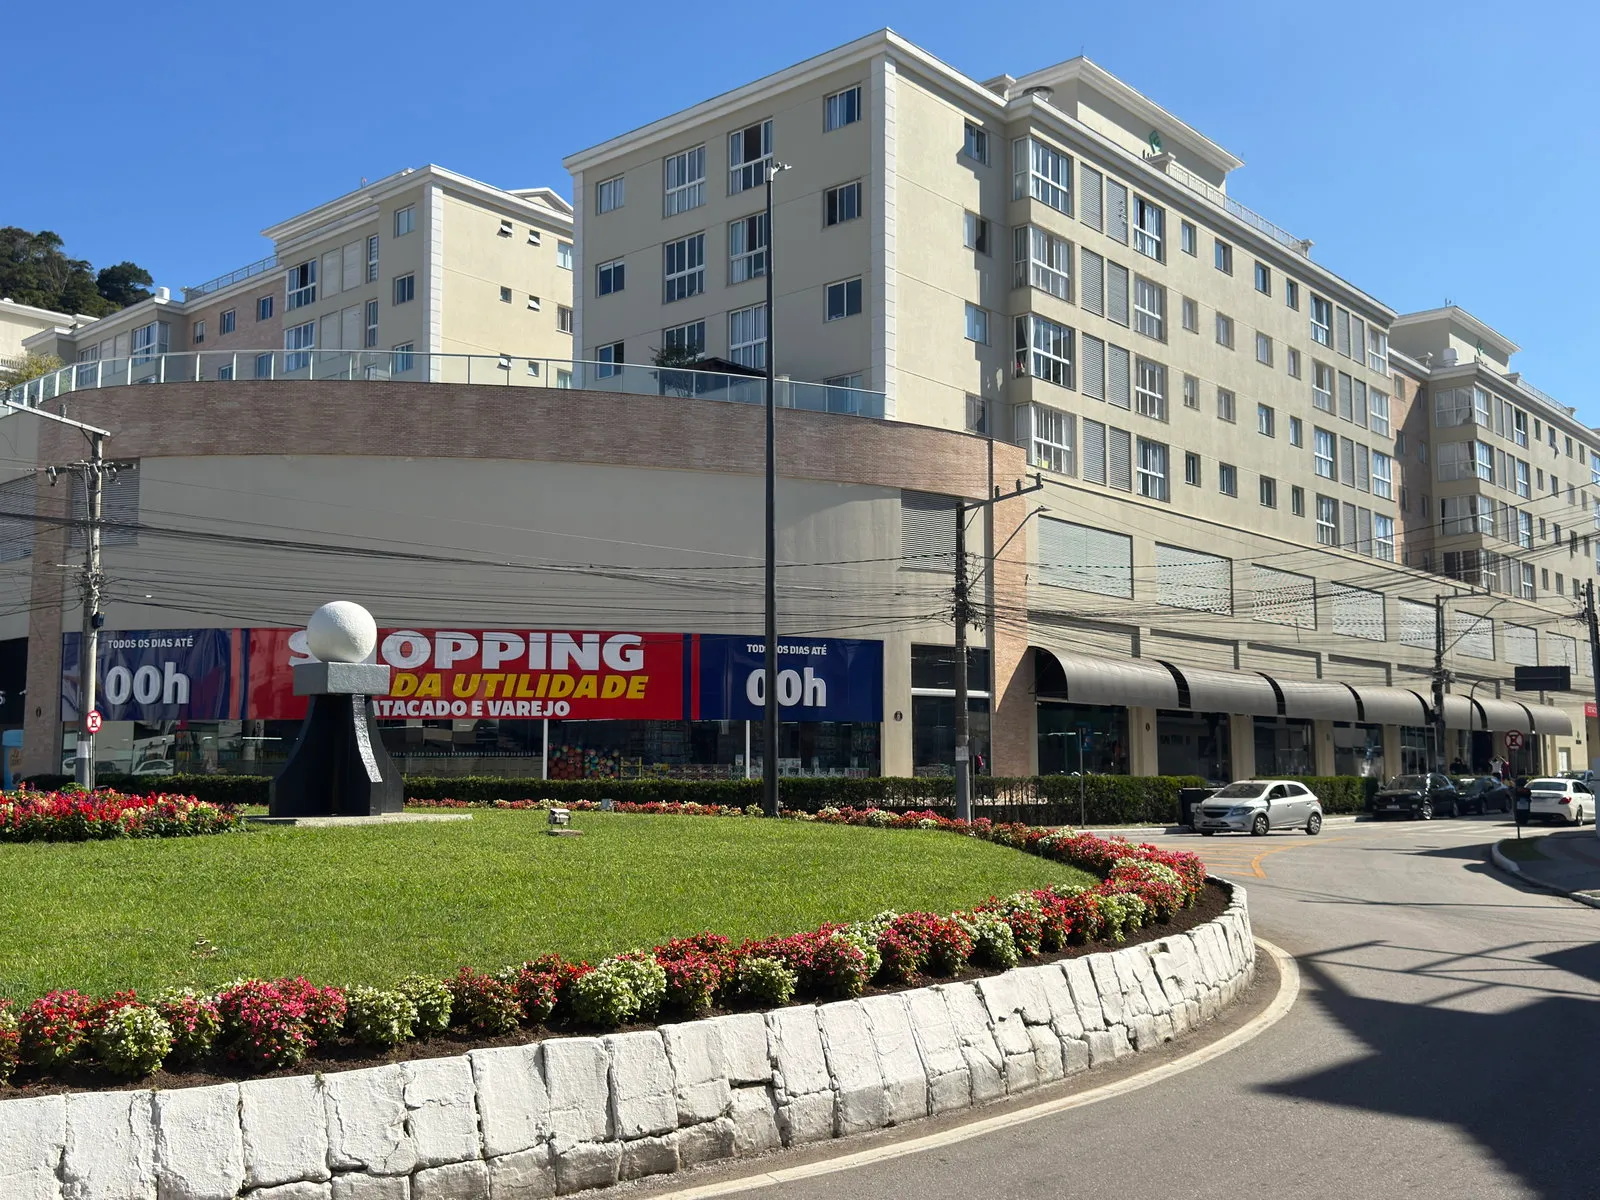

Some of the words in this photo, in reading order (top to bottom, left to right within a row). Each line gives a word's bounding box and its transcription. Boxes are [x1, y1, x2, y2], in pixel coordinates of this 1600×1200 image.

[108, 639, 136, 649] TODOS
[138, 639, 150, 648] OS
[152, 638, 173, 648] DIAS
[174, 635, 193, 647] ATÉ
[747, 644, 766, 654] TOD
[777, 645, 789, 654] OS
[790, 645, 810, 655] DIAS
[811, 644, 827, 655] ATÉ
[288, 630, 645, 671] SOPPING
[391, 673, 441, 697] DA
[452, 673, 649, 699] UTILIDADE
[471, 700, 483, 716] E
[487, 700, 571, 716] VAREJO
